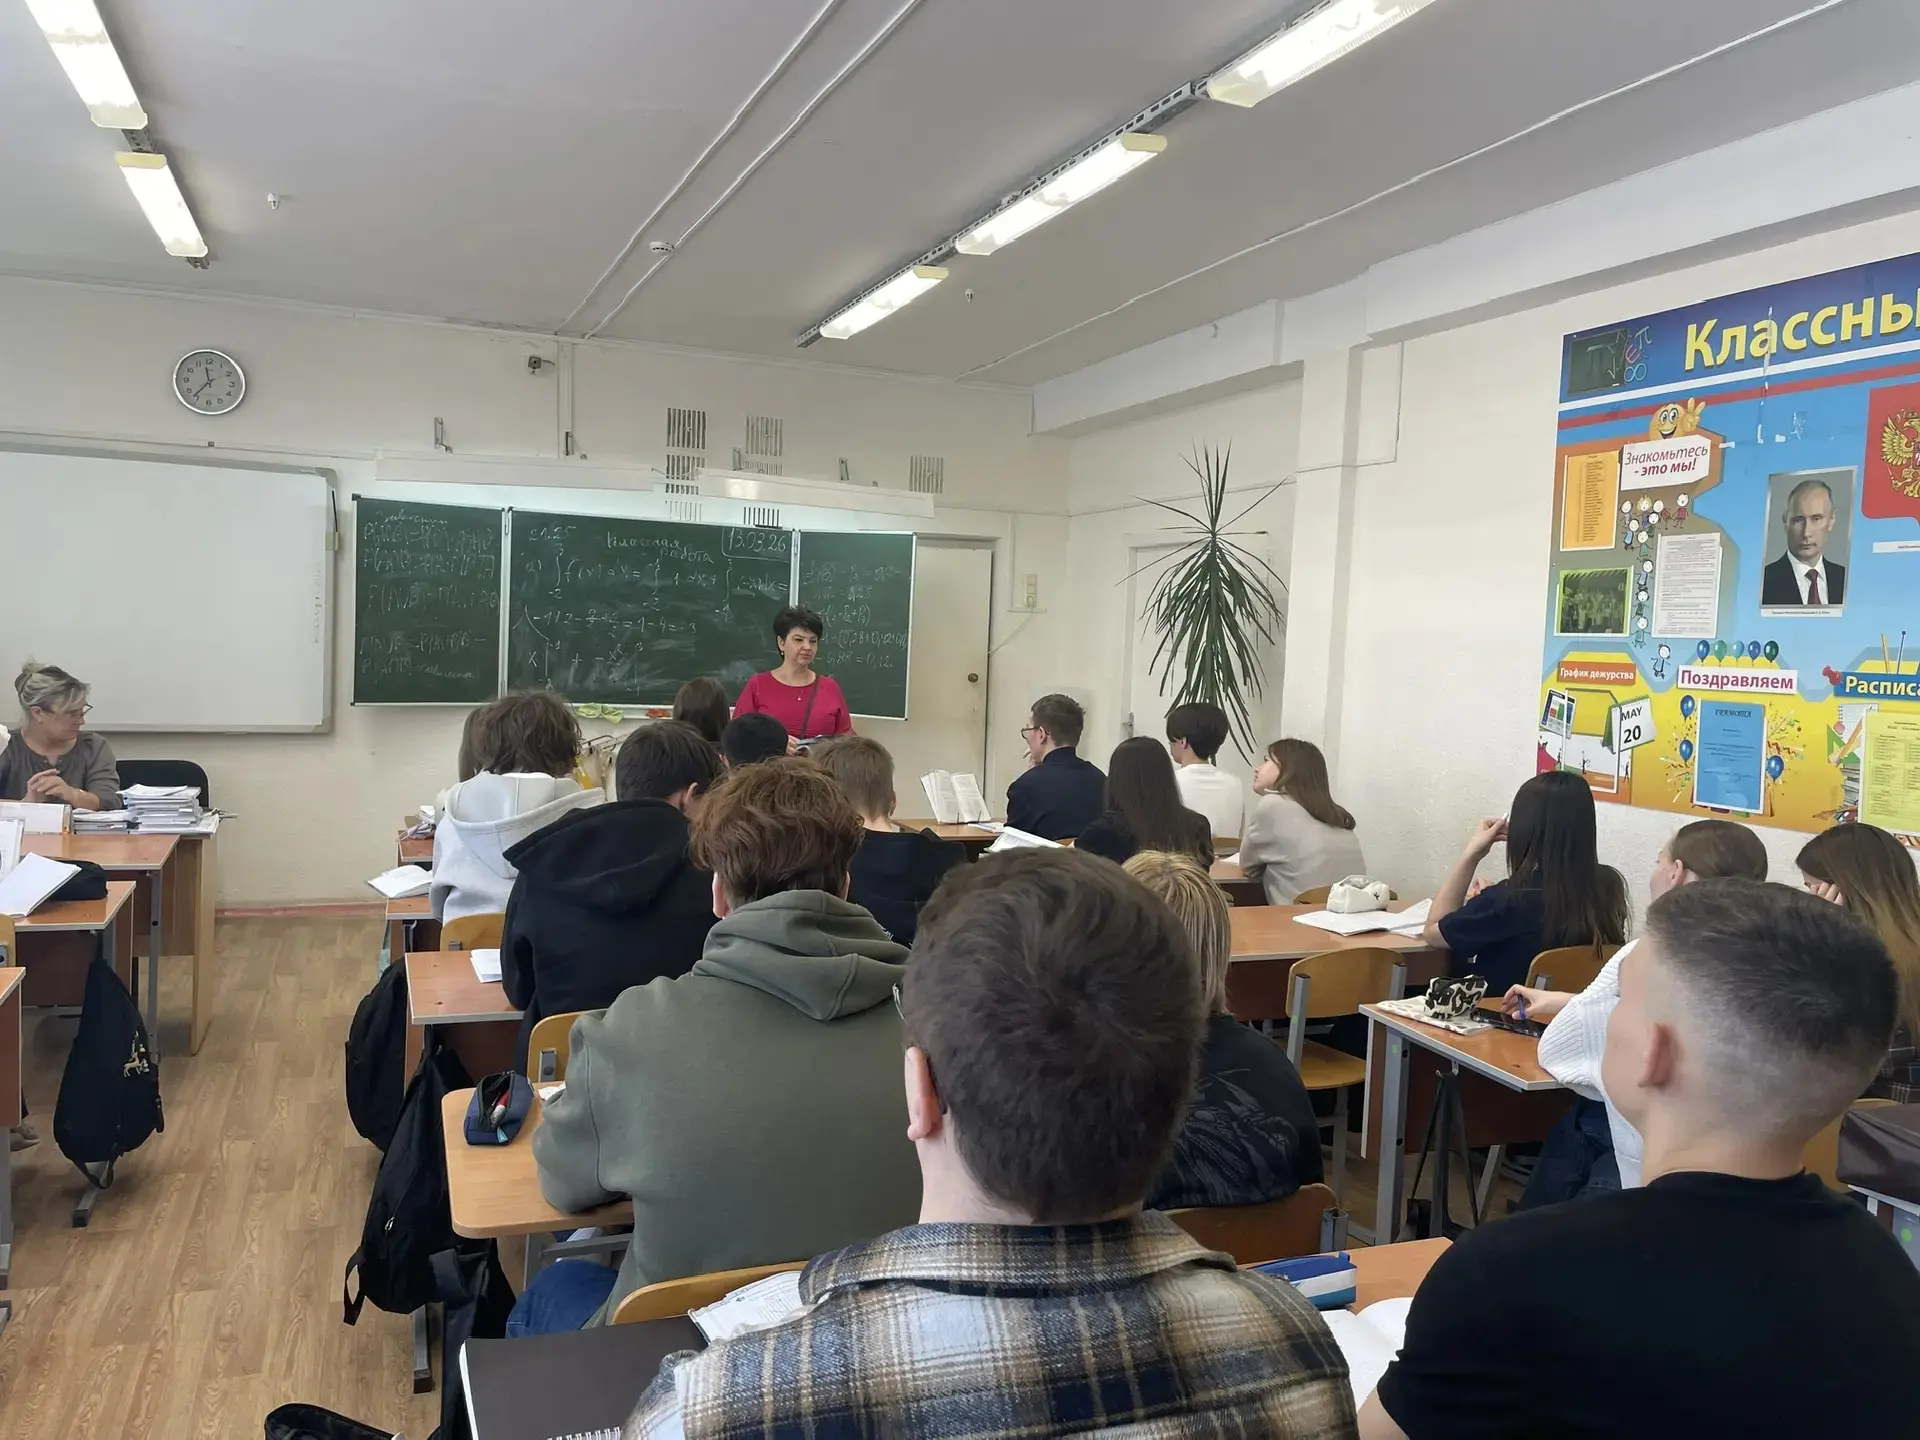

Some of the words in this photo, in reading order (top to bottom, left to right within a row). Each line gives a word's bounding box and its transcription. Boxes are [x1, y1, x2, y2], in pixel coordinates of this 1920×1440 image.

[1624, 446, 1708, 466] Знакомьтесь
[1641, 464, 1667, 477] это
[1670, 458, 1697, 473] мы!
[728, 527, 786, 552] 13.03.26
[1560, 667, 1588, 678] График
[1590, 669, 1634, 682] дежурства
[1681, 670, 1793, 690] Поздравляем
[1621, 706, 1642, 722] MAY
[1624, 725, 1642, 744] 20
